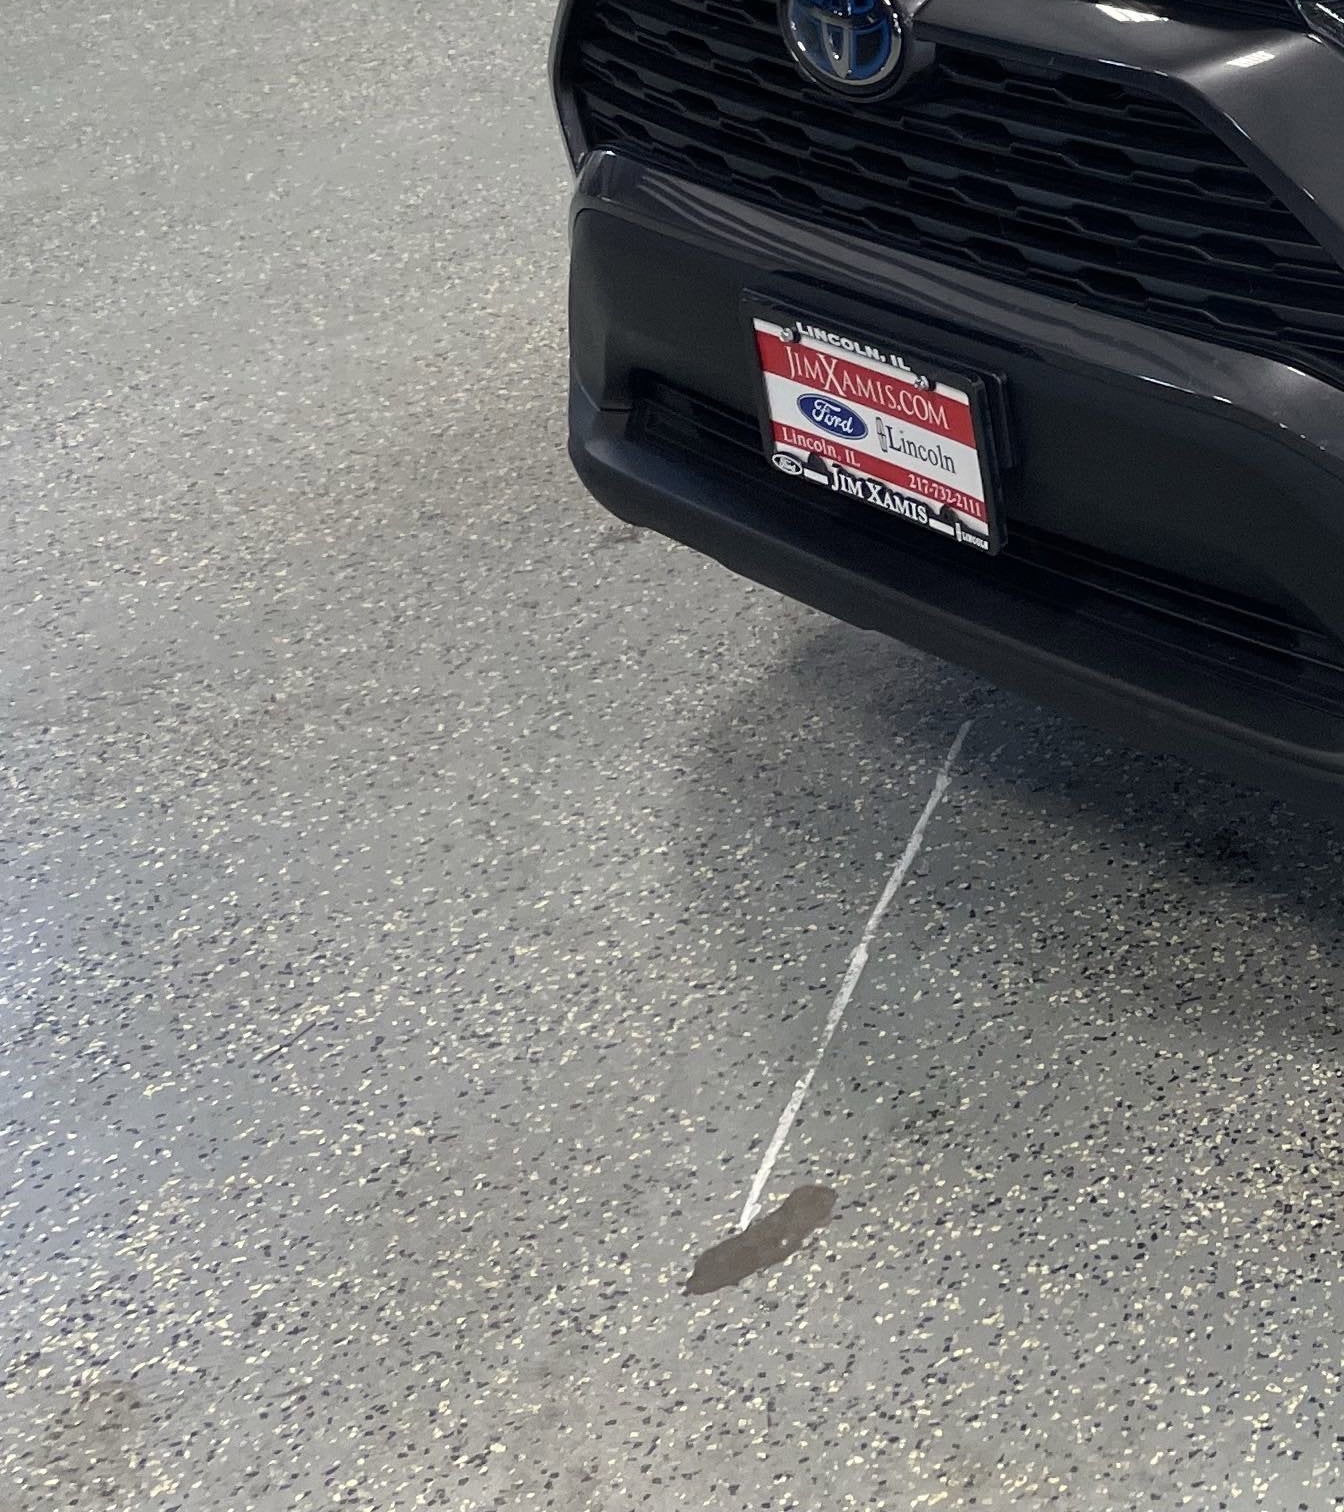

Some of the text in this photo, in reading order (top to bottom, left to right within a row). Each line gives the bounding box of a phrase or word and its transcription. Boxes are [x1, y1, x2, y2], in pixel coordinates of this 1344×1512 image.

[796, 322, 911, 371] LINCOLN, IL
[785, 346, 950, 429] JIMXAMIS.COM
[812, 399, 854, 434] Ford
[782, 427, 861, 468] Lincoln, IL
[886, 425, 957, 474] Lincoln
[831, 464, 928, 524] JIM XAMIS
